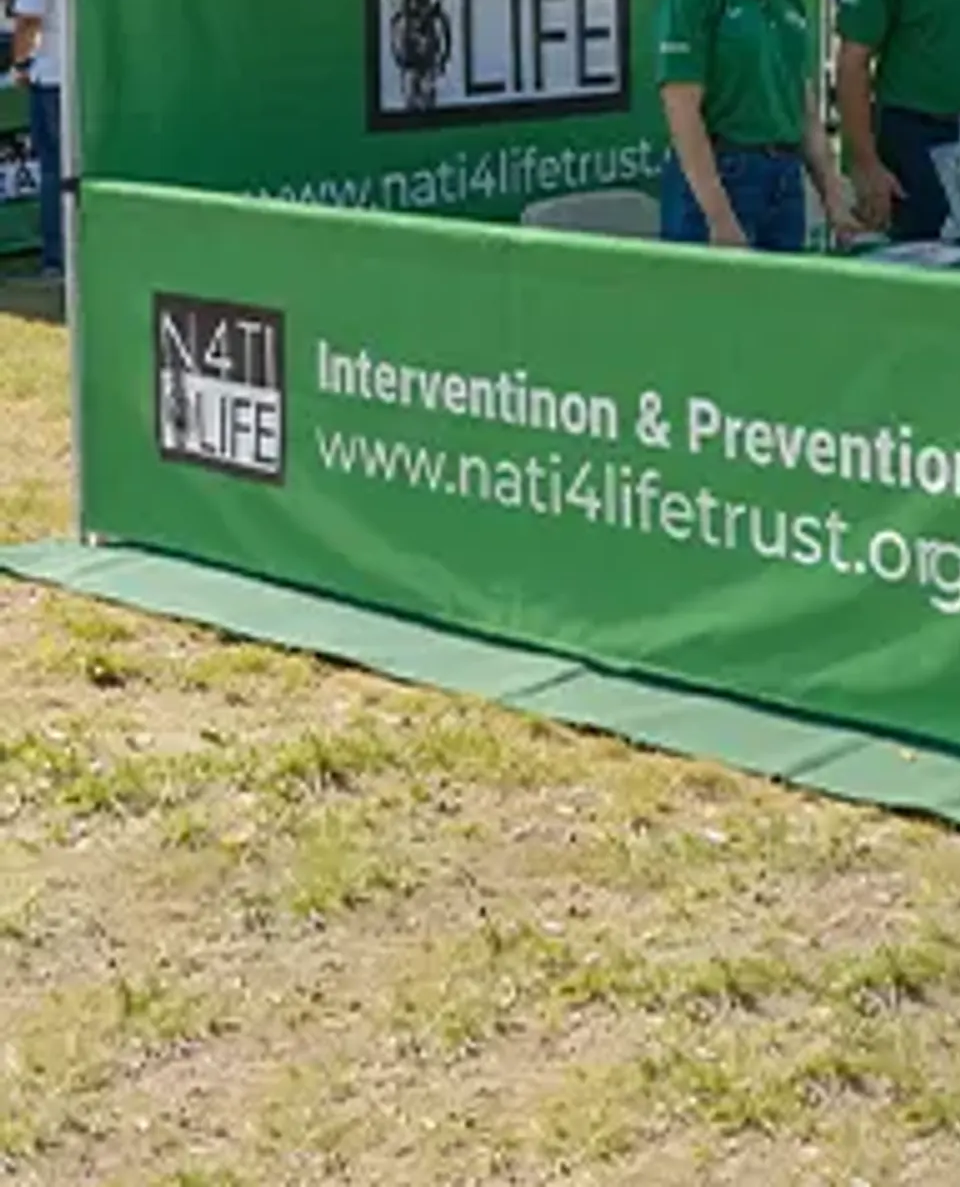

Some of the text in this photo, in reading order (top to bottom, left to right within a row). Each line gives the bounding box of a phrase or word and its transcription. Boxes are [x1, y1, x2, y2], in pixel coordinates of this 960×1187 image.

[161, 311, 276, 387] N4TI
[196, 390, 278, 464] LIFE
[317, 340, 619, 440] Interventinon
[635, 390, 672, 449] &
